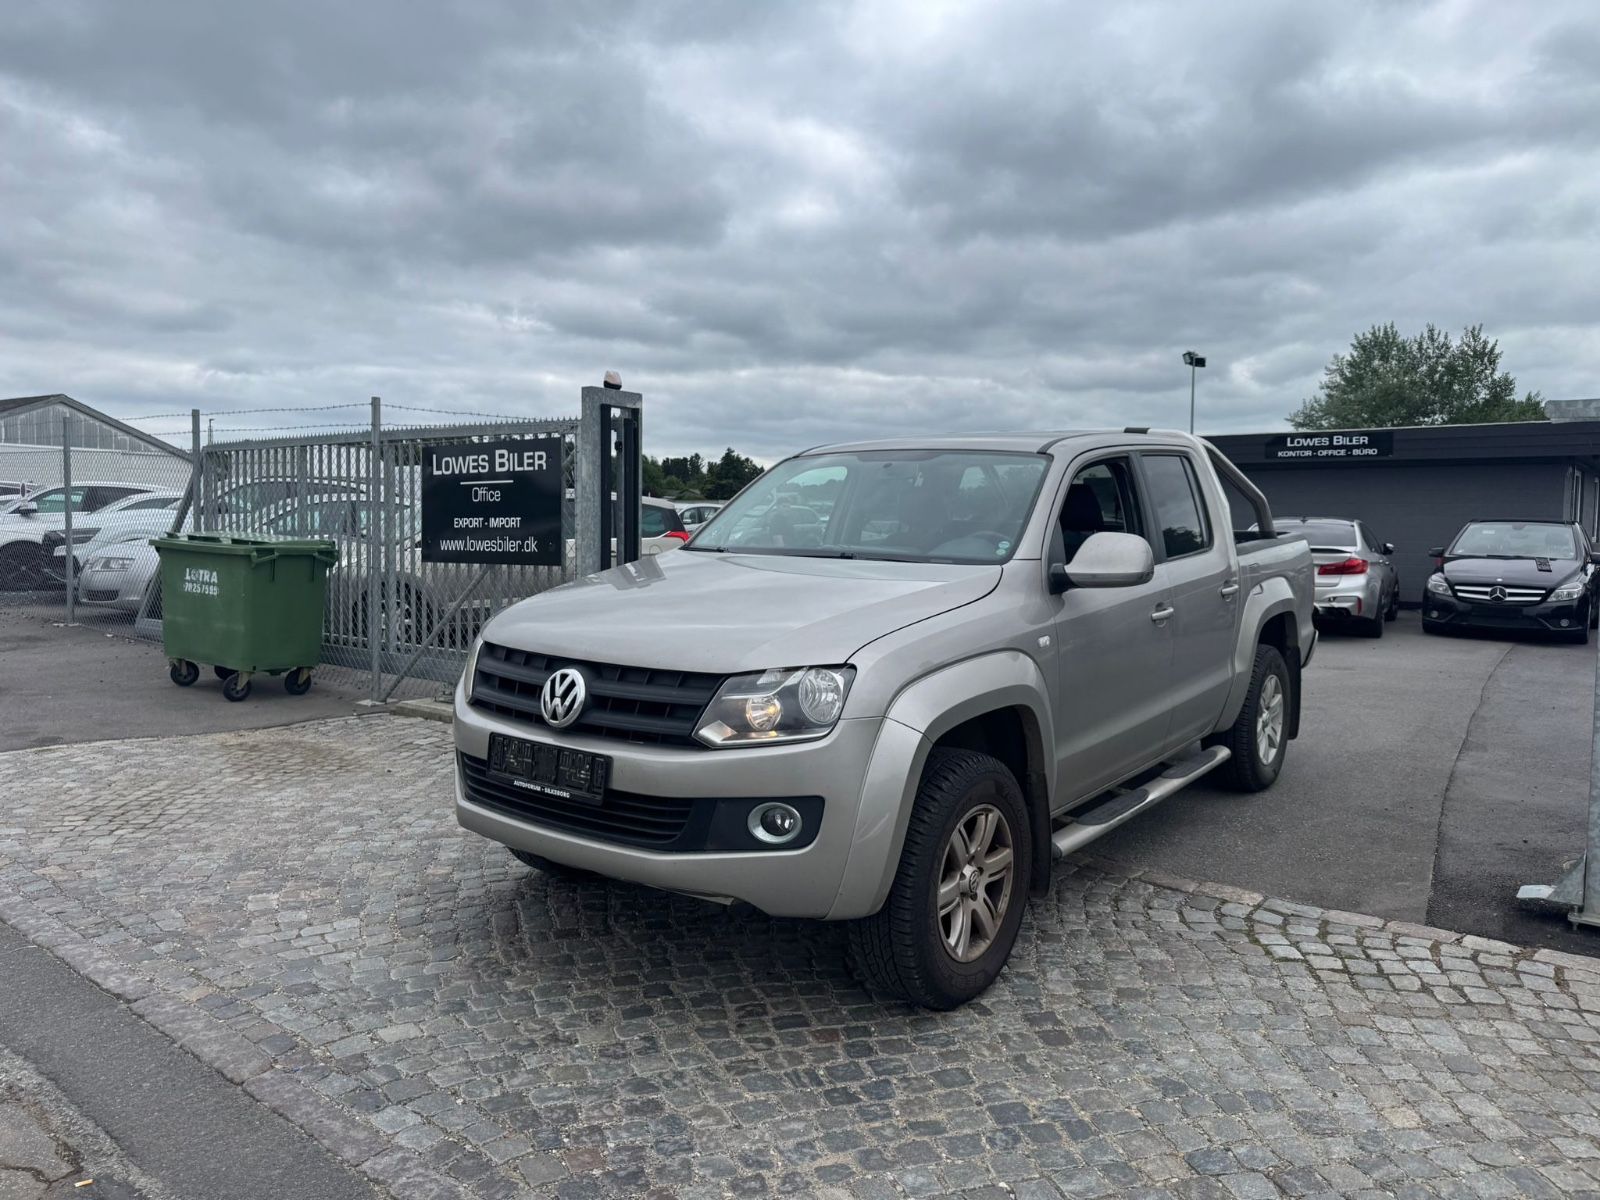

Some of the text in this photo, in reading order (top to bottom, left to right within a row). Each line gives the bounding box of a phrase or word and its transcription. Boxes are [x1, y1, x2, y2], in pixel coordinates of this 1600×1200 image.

[1287, 435, 1369, 447] LOWES BILER
[1352, 447, 1378, 456] BÜRO
[432, 449, 547, 475] LOWES BILER
[472, 487, 501, 502] Office
[453, 517, 484, 528] EXPORT
[489, 517, 521, 528] IMPORT
[440, 535, 538, 552] www.lowesbiler.dk
